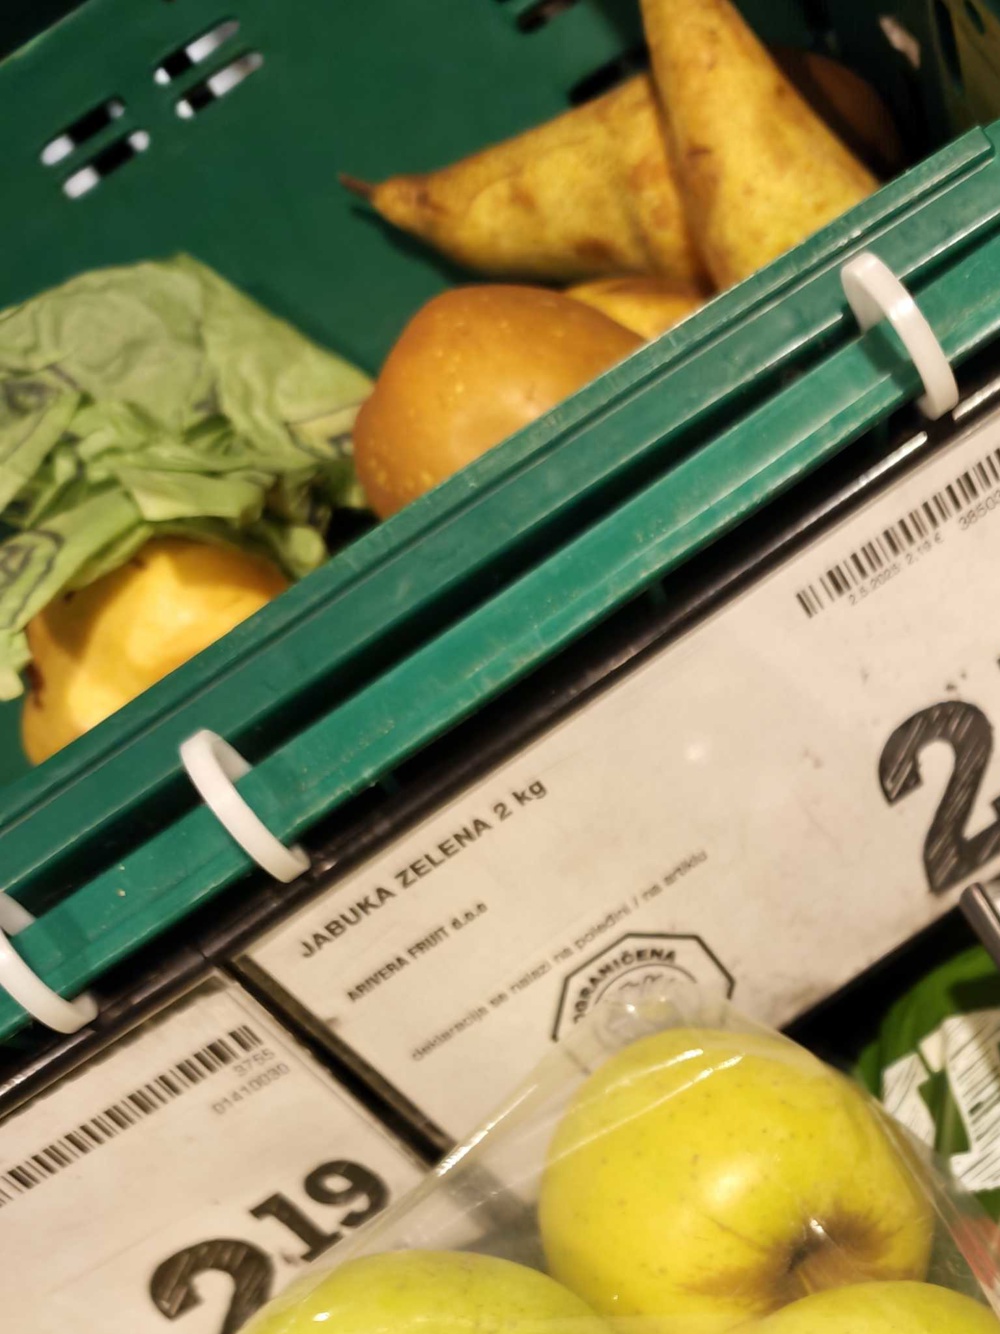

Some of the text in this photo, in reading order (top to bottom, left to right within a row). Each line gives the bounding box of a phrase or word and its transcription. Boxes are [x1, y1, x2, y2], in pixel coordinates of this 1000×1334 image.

[301, 780, 547, 958] JABUKA ZELENA 2 kg
[347, 957, 409, 1001] ARIVERA
[407, 926, 450, 959] FRUIT
[412, 1004, 489, 1062] deklaracija
[490, 993, 508, 1008] se
[510, 962, 552, 994] nalazi
[553, 948, 574, 965] na
[575, 902, 631, 952] poleđini
[641, 884, 662, 901] na
[664, 850, 708, 886] artiklu
[233, 1048, 275, 1077] 3755
[249, 1159, 391, 1263] 19
